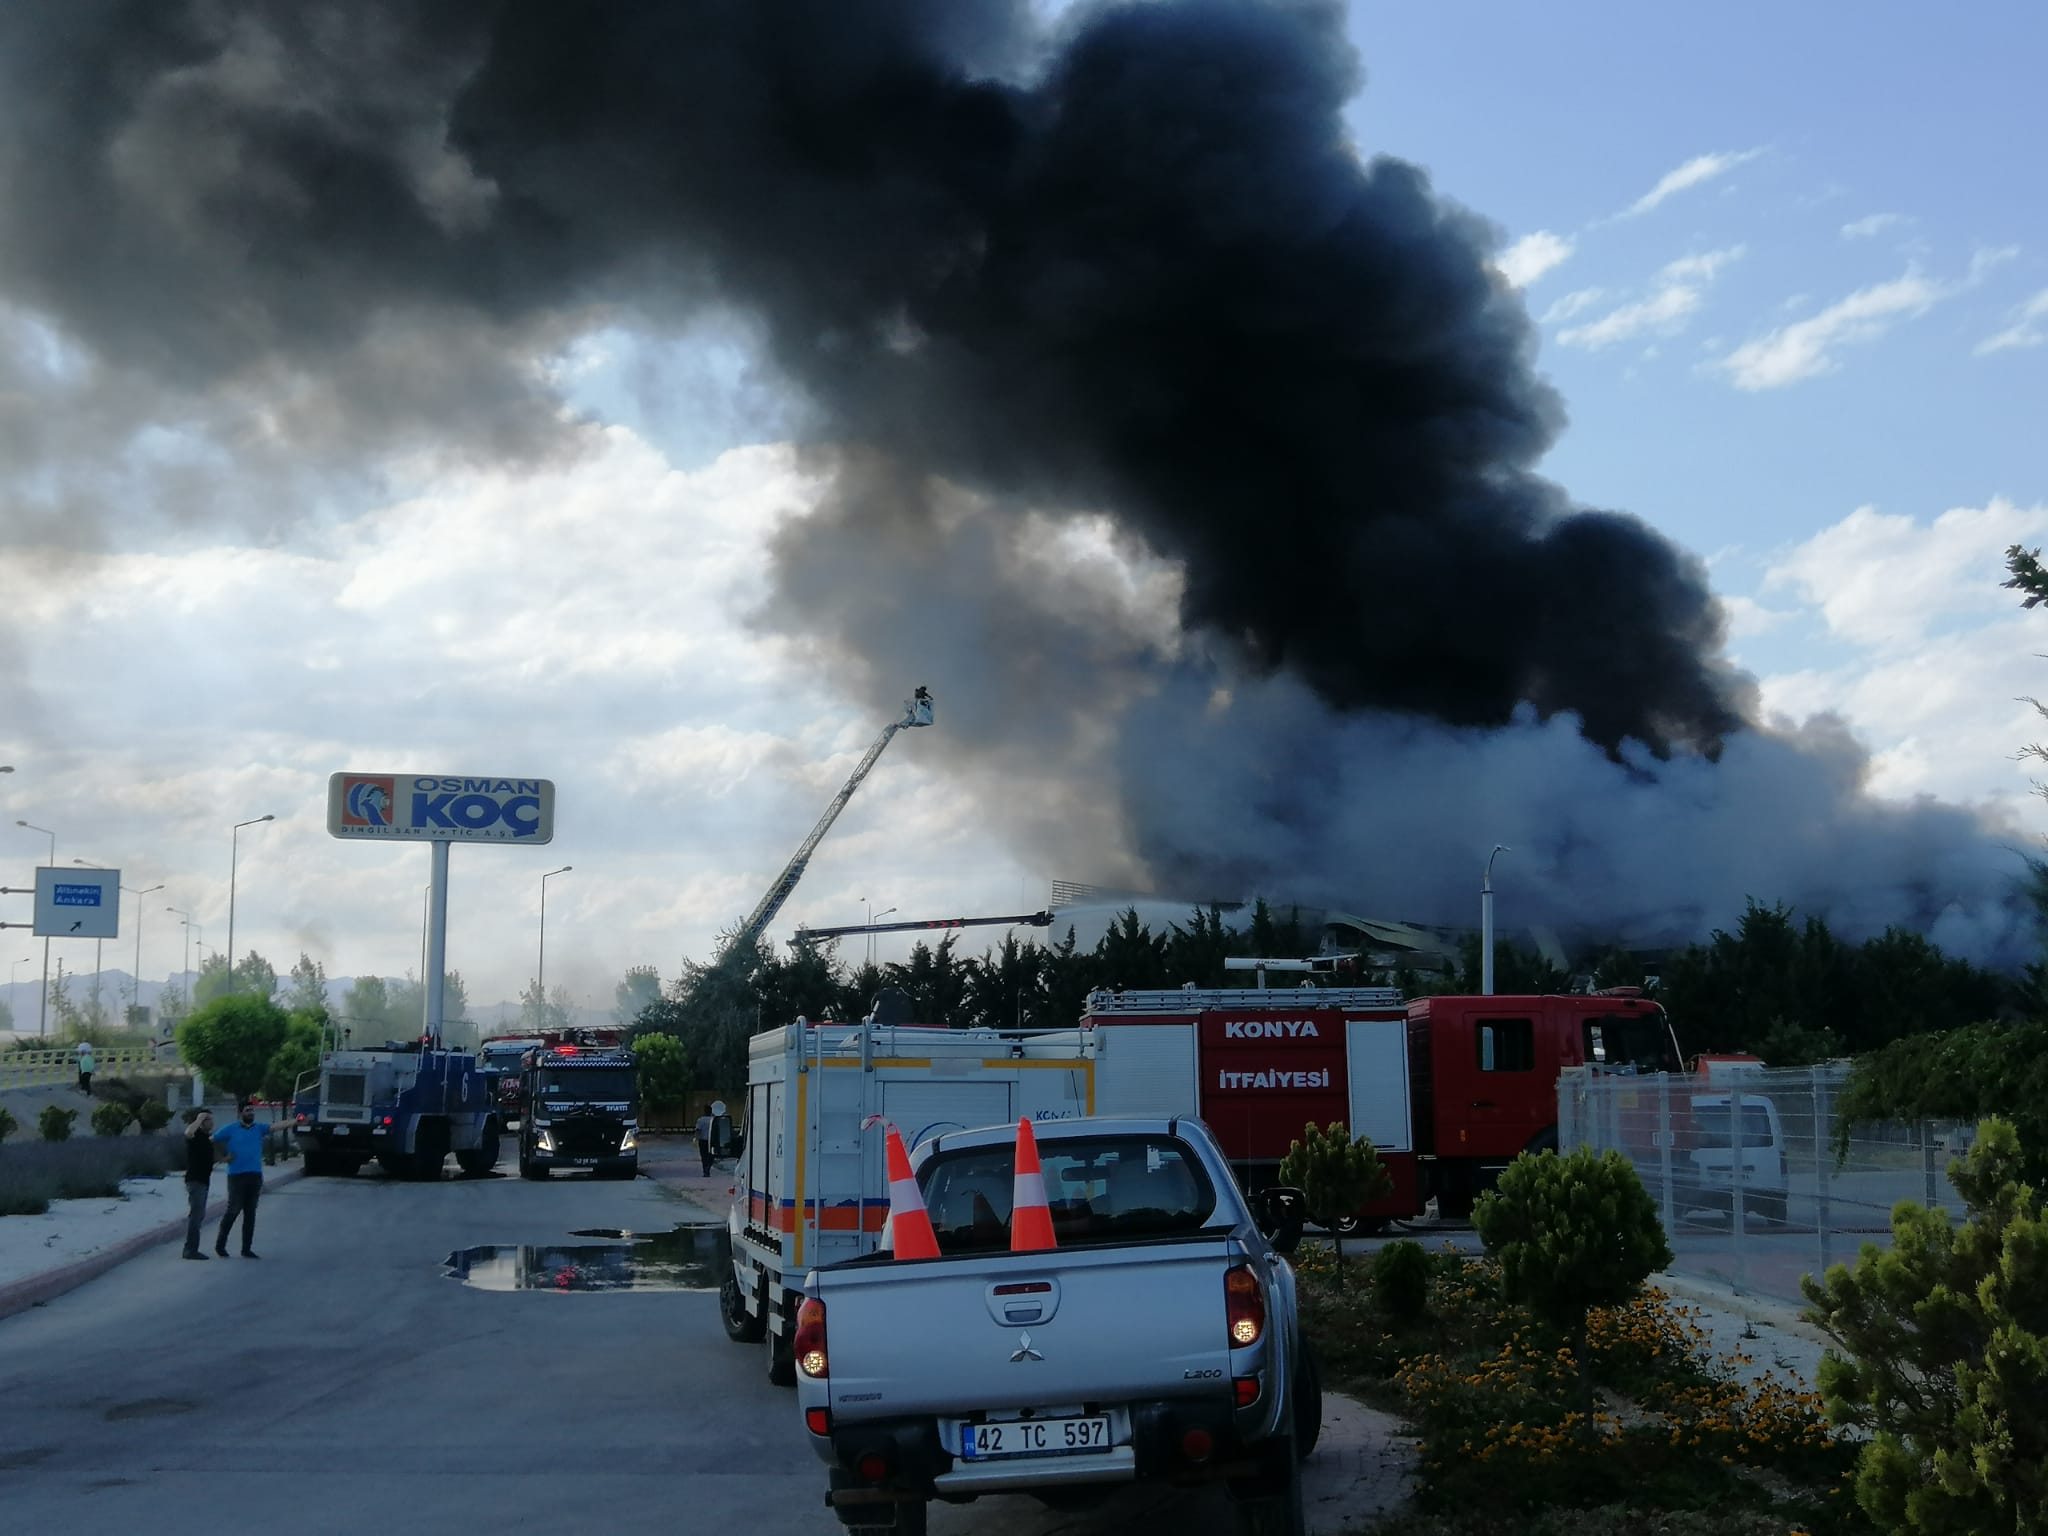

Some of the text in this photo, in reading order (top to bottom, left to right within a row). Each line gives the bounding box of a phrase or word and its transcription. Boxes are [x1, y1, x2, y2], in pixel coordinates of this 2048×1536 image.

[414, 778, 539, 794] OSMAN
[411, 793, 540, 837] KOÇ
[56, 896, 94, 904] Ankara
[1225, 1021, 1319, 1038] KONYA
[461, 1071, 469, 1102] 6
[1219, 1068, 1329, 1089] İTFAİYESİ
[1184, 1369, 1222, 1379] L200
[977, 1428, 1003, 1451] 42
[1020, 1424, 1046, 1448] TC
[1064, 1421, 1104, 1446] 597
